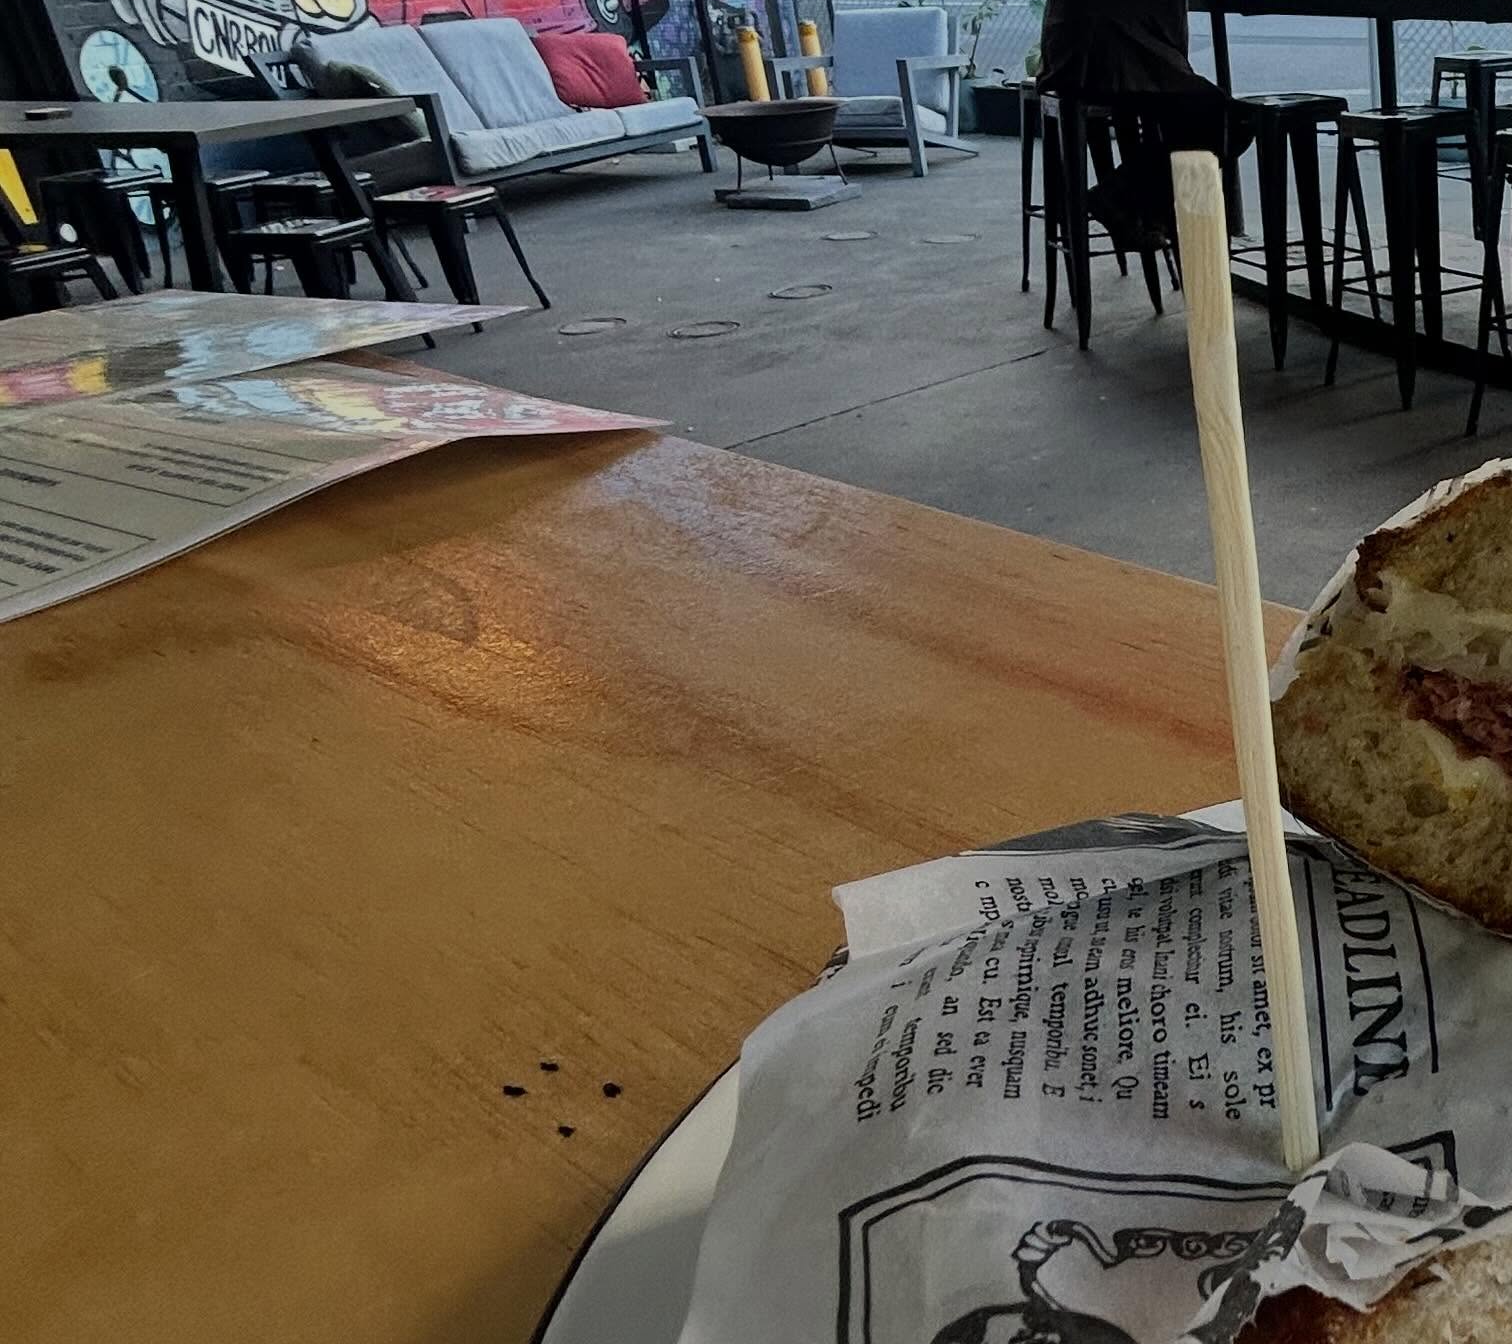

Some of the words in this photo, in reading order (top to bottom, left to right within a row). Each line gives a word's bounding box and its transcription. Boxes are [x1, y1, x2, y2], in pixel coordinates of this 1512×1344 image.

[942, 996, 960, 1016] an
[977, 997, 1002, 1022] Est
[1082, 977, 1104, 1041] adhuc
[1150, 984, 1171, 1043] choro
[1185, 1003, 1207, 1028] ei.
[1252, 980, 1273, 1037] amet,
[1220, 1011, 1243, 1045] his
[934, 1032, 956, 1056] sed
[1000, 1031, 1028, 1100] nusquam
[1075, 1045, 1100, 1091] sonet,
[1188, 1053, 1211, 1081] Ei
[1258, 1047, 1274, 1074] ex
[927, 1068, 952, 1095] dic
[1111, 1075, 1139, 1100] Qu
[1152, 1050, 1176, 1120] timeam
[1223, 1071, 1247, 1120] sole
[1253, 1082, 1276, 1109] pr
